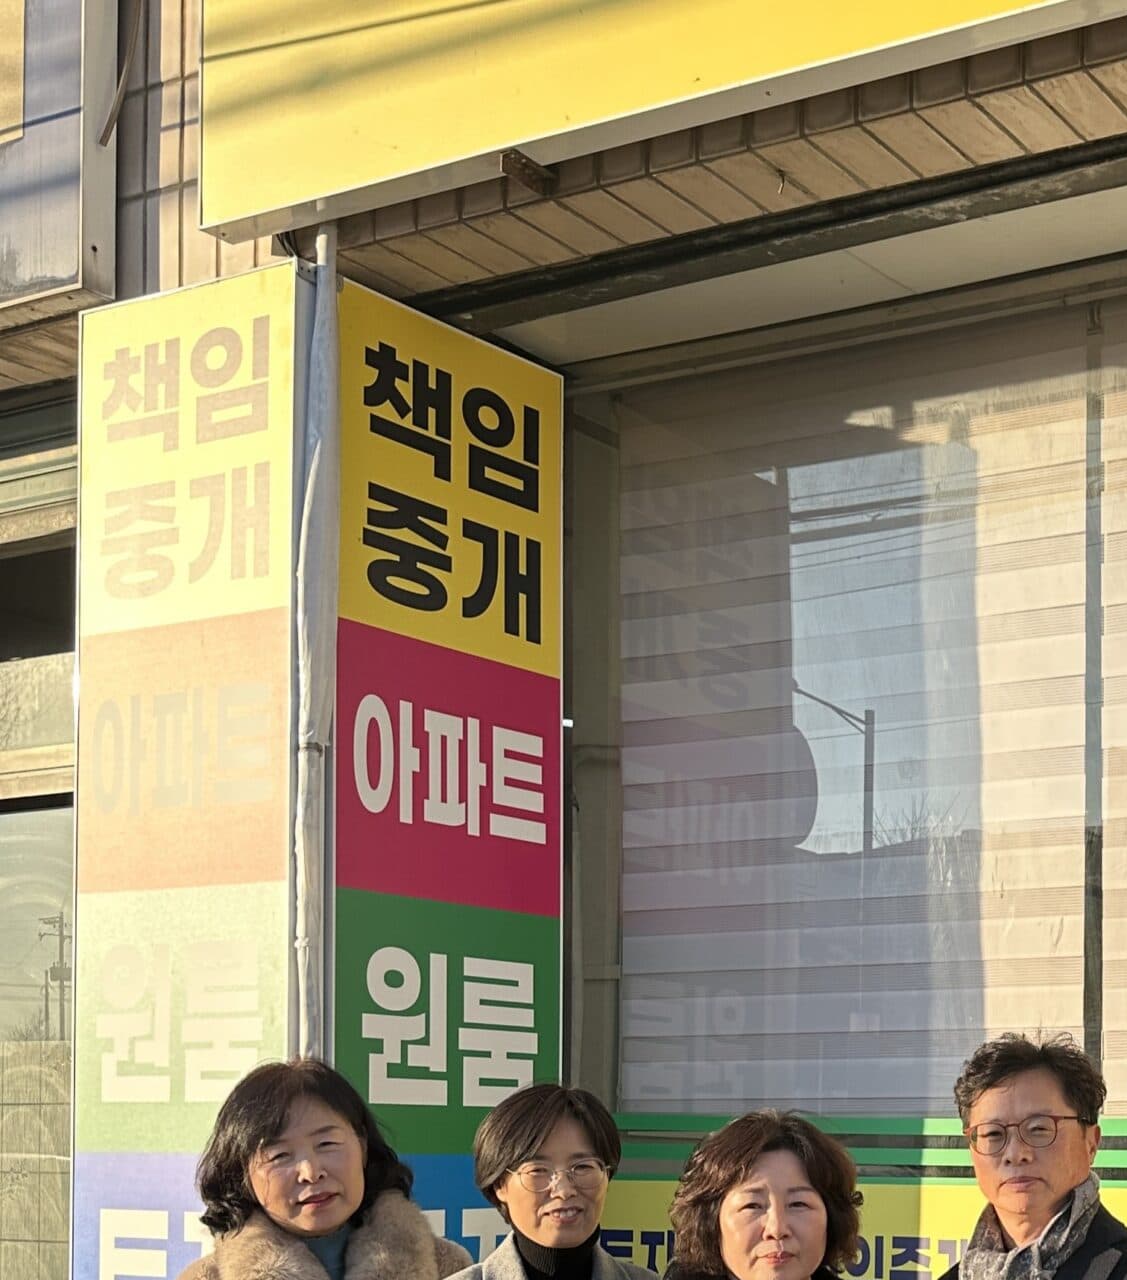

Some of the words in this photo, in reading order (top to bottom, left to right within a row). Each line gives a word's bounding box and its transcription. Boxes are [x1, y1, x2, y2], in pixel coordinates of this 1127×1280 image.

[101, 315, 271, 452] 책임
[363, 341, 540, 513] 책임
[103, 460, 271, 601] 중개
[362, 481, 542, 646] 중개
[353, 694, 547, 845] 아파트
[96, 942, 263, 1103] 원룸
[361, 946, 539, 1107] 원룸
